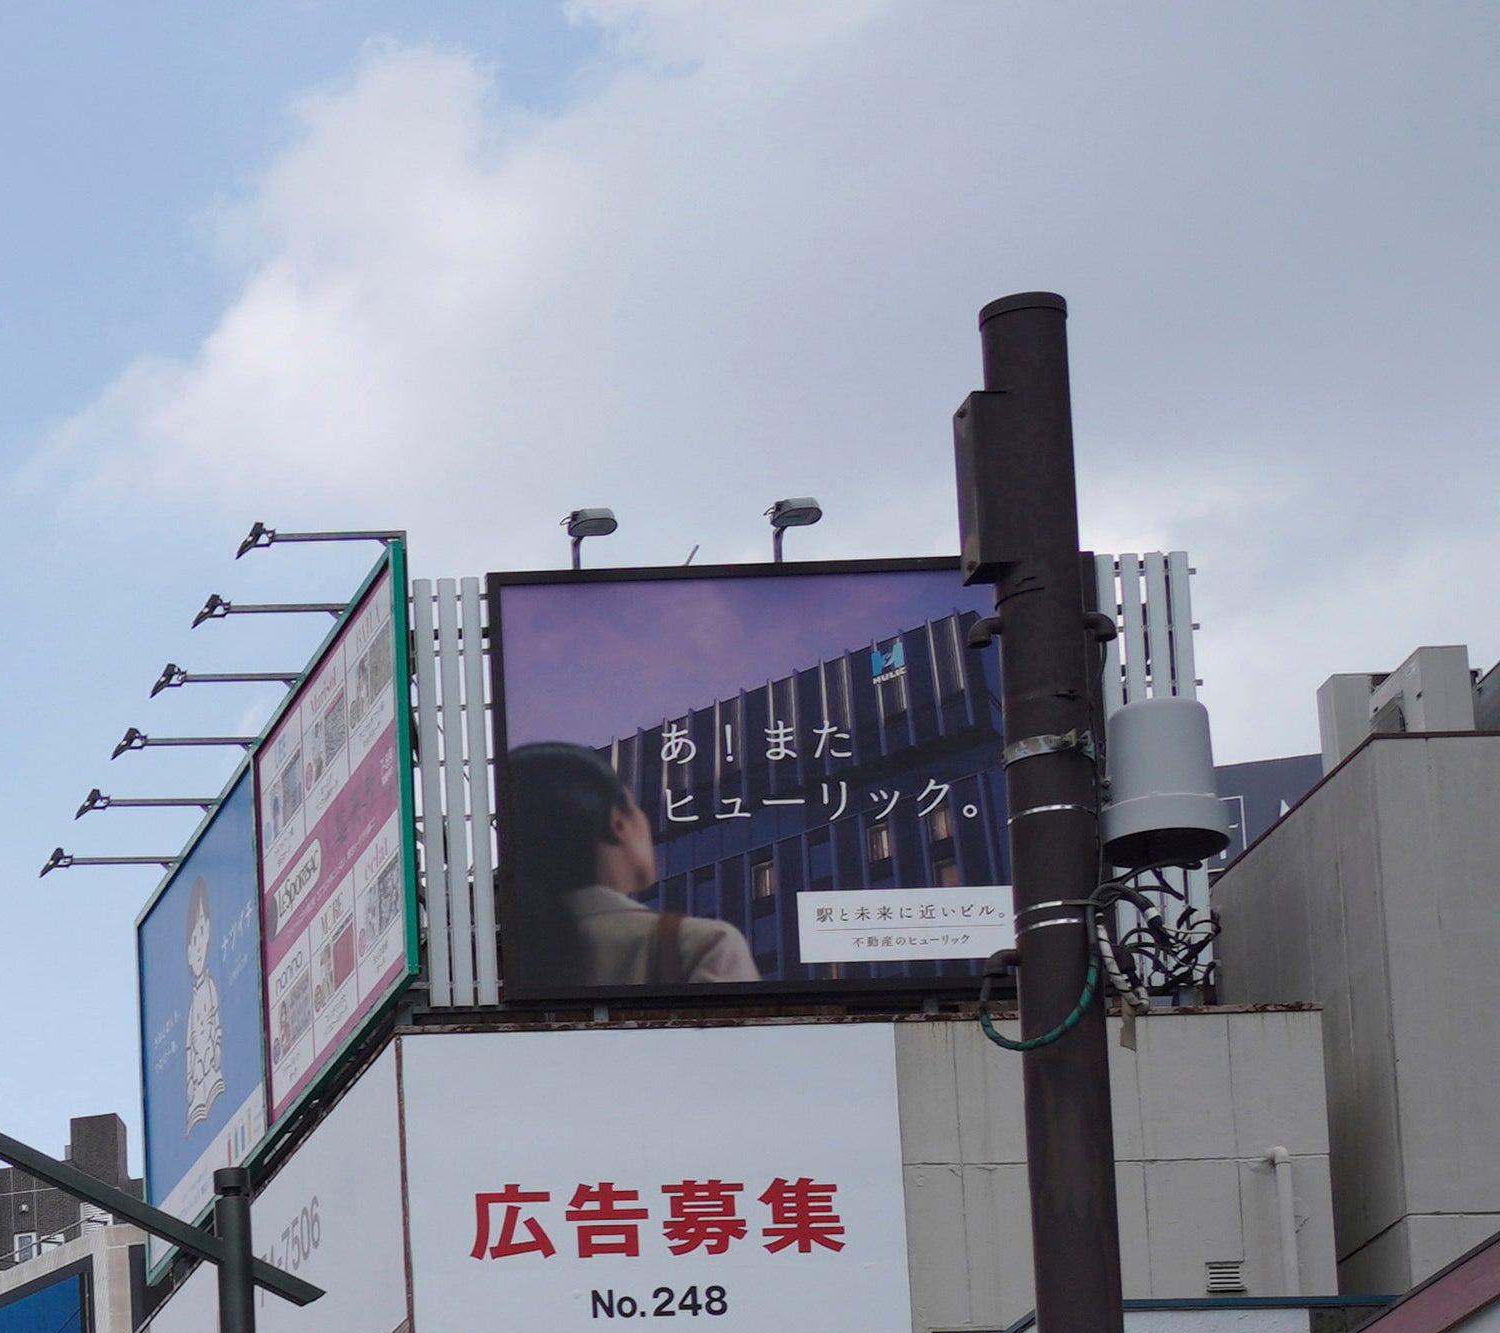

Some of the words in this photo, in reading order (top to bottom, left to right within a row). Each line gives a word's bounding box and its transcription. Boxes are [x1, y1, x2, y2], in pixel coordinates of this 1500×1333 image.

[664, 778, 980, 825] ヒューリック。
[815, 903, 1005, 924] 駅と未来に近いビル。
[852, 933, 971, 948] 不動産のヒューリック
[470, 1177, 847, 1261] 広告募集
[590, 1285, 729, 1320] No.248
